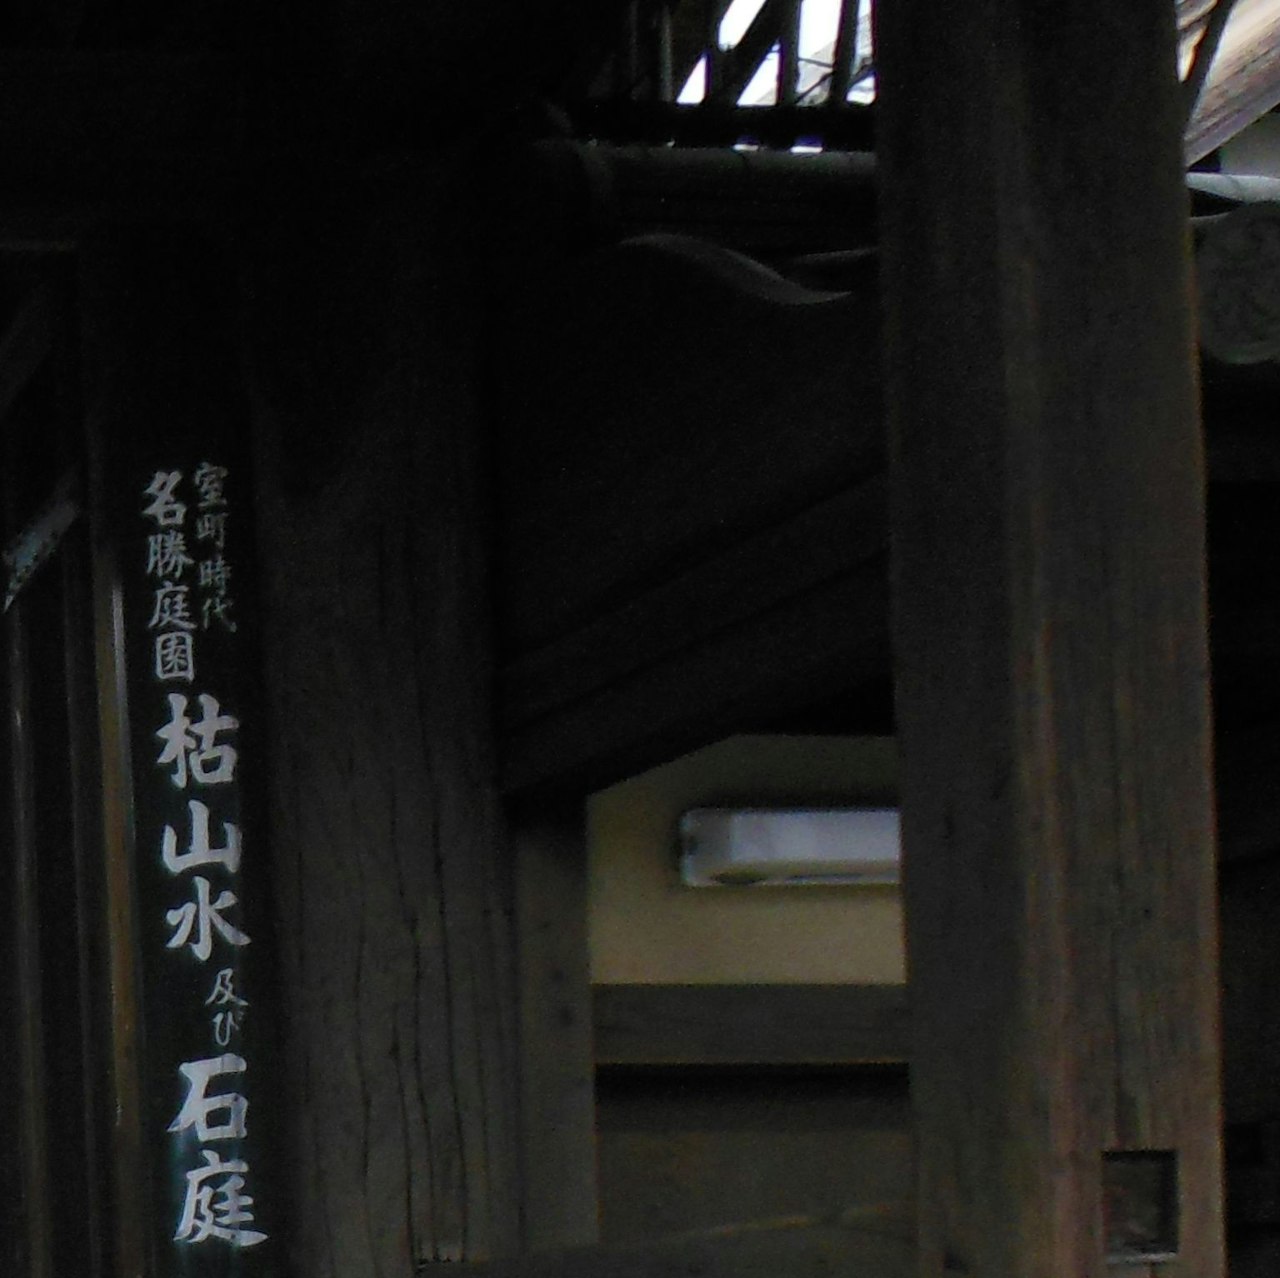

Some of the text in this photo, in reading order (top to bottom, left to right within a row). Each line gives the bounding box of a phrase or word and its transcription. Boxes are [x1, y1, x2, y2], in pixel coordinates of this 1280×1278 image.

[142, 471, 197, 681] 名勝庭園
[193, 462, 237, 632] 室町時代
[155, 693, 269, 1247] 枯山水 及び 石庭
